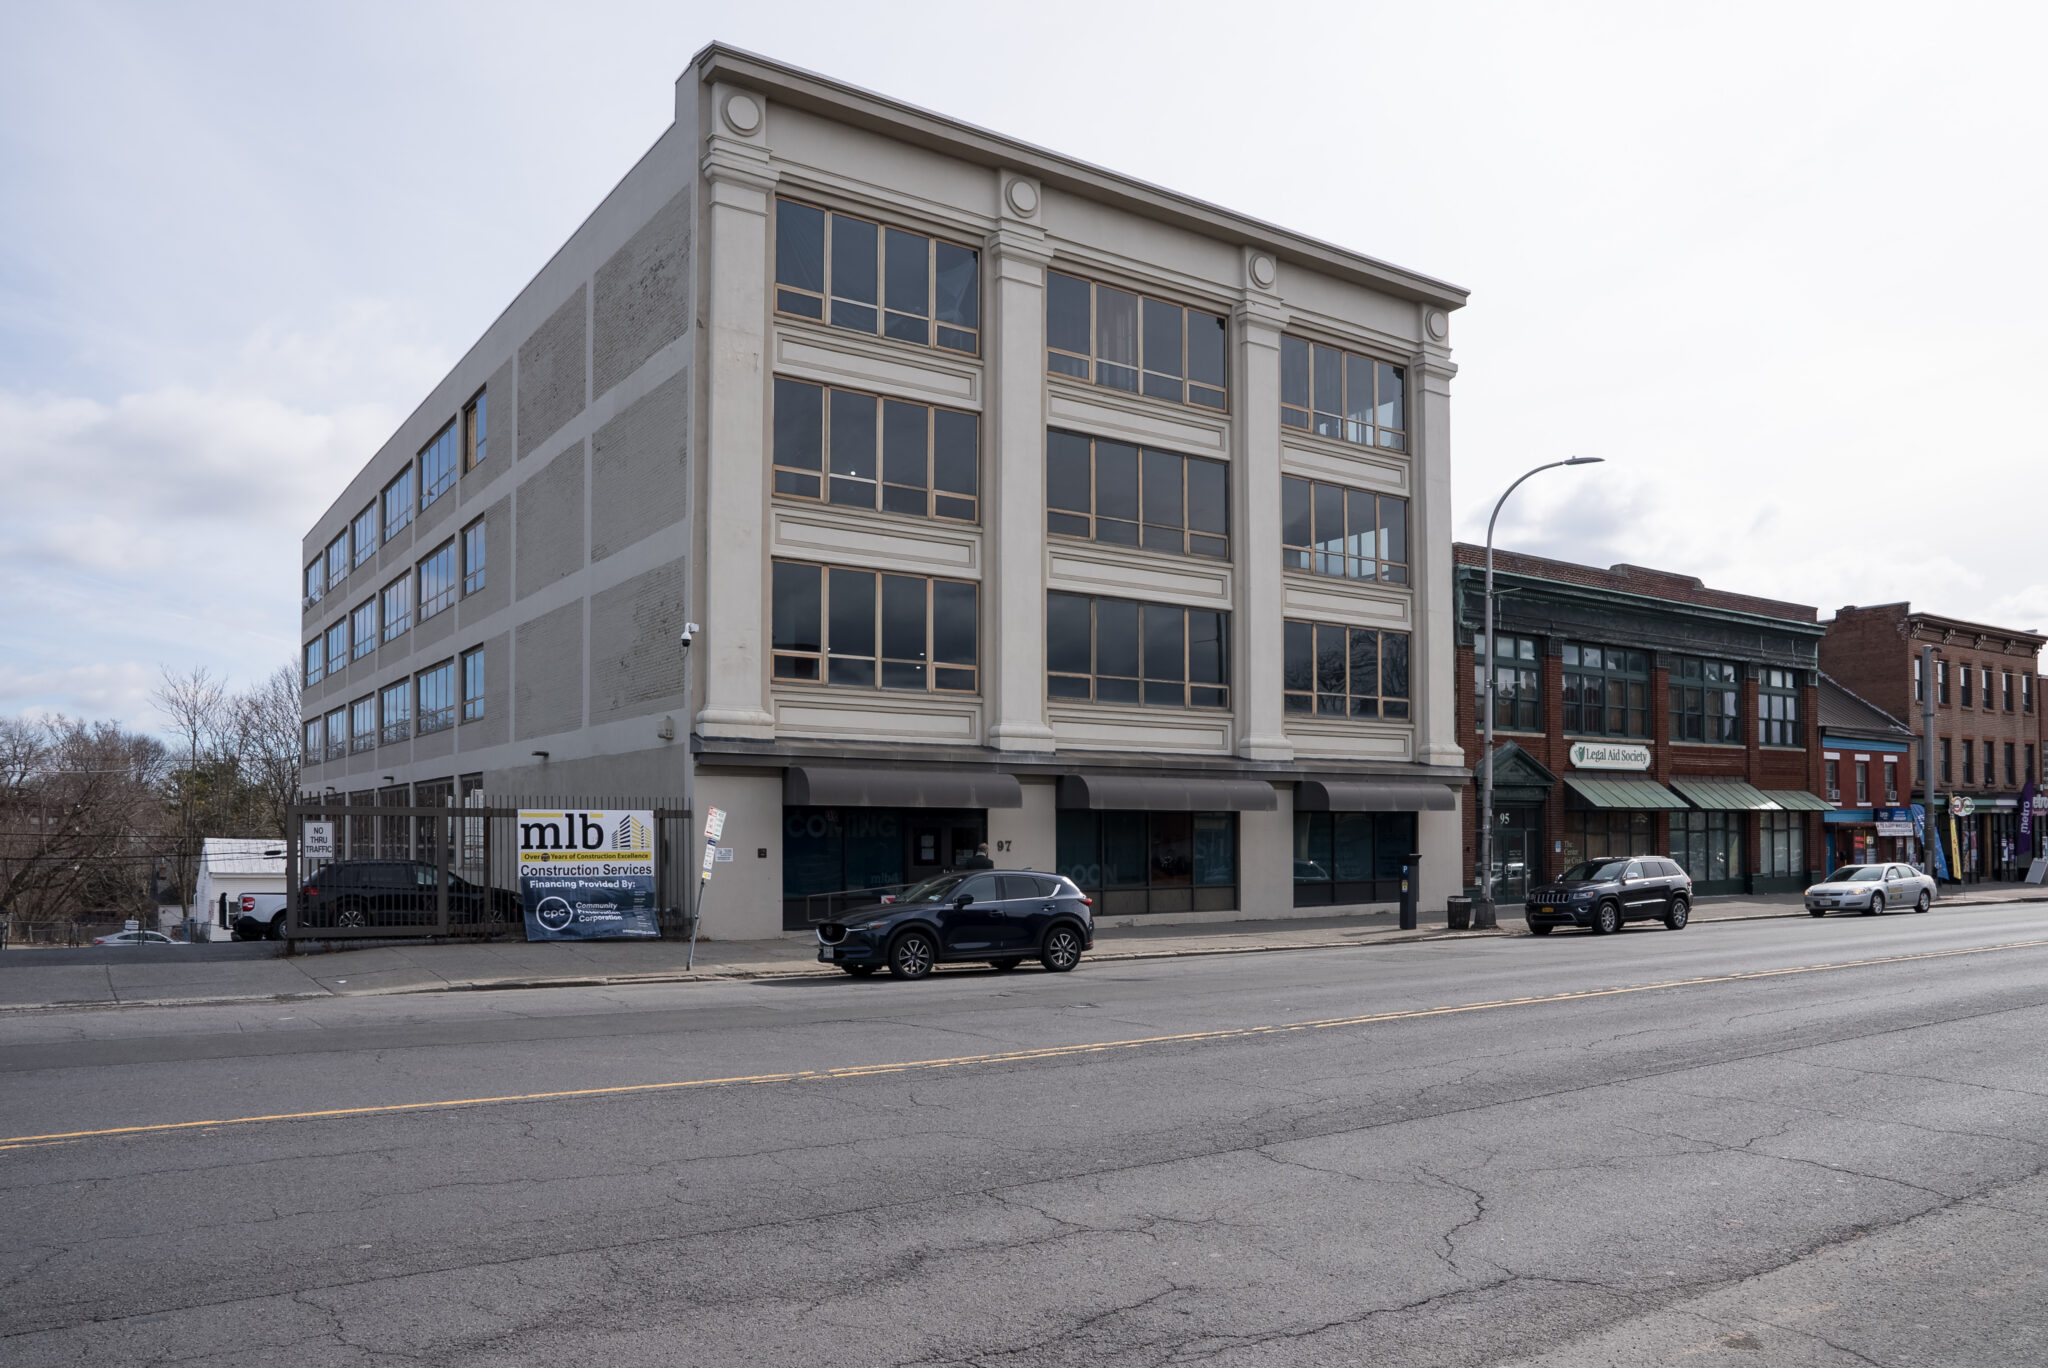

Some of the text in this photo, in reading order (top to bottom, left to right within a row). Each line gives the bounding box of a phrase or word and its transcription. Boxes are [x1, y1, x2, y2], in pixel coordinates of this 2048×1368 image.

[1586, 748, 1647, 764] Legal Aid Society
[2033, 794, 2048, 809] etro
[1500, 812, 1510, 825] 95
[2020, 801, 2030, 835] metro
[313, 827, 324, 835] NO
[520, 813, 604, 850] mlb
[310, 836, 328, 844] THRU
[305, 845, 332, 853] TRAFFIC
[997, 840, 1012, 852] 97
[569, 852, 576, 860] of
[520, 864, 652, 877] Construction Services
[530, 880, 636, 889] Financing Provided By:
[575, 901, 618, 910] Community
[543, 908, 566, 919] cpc
[579, 915, 623, 923] Corporation
